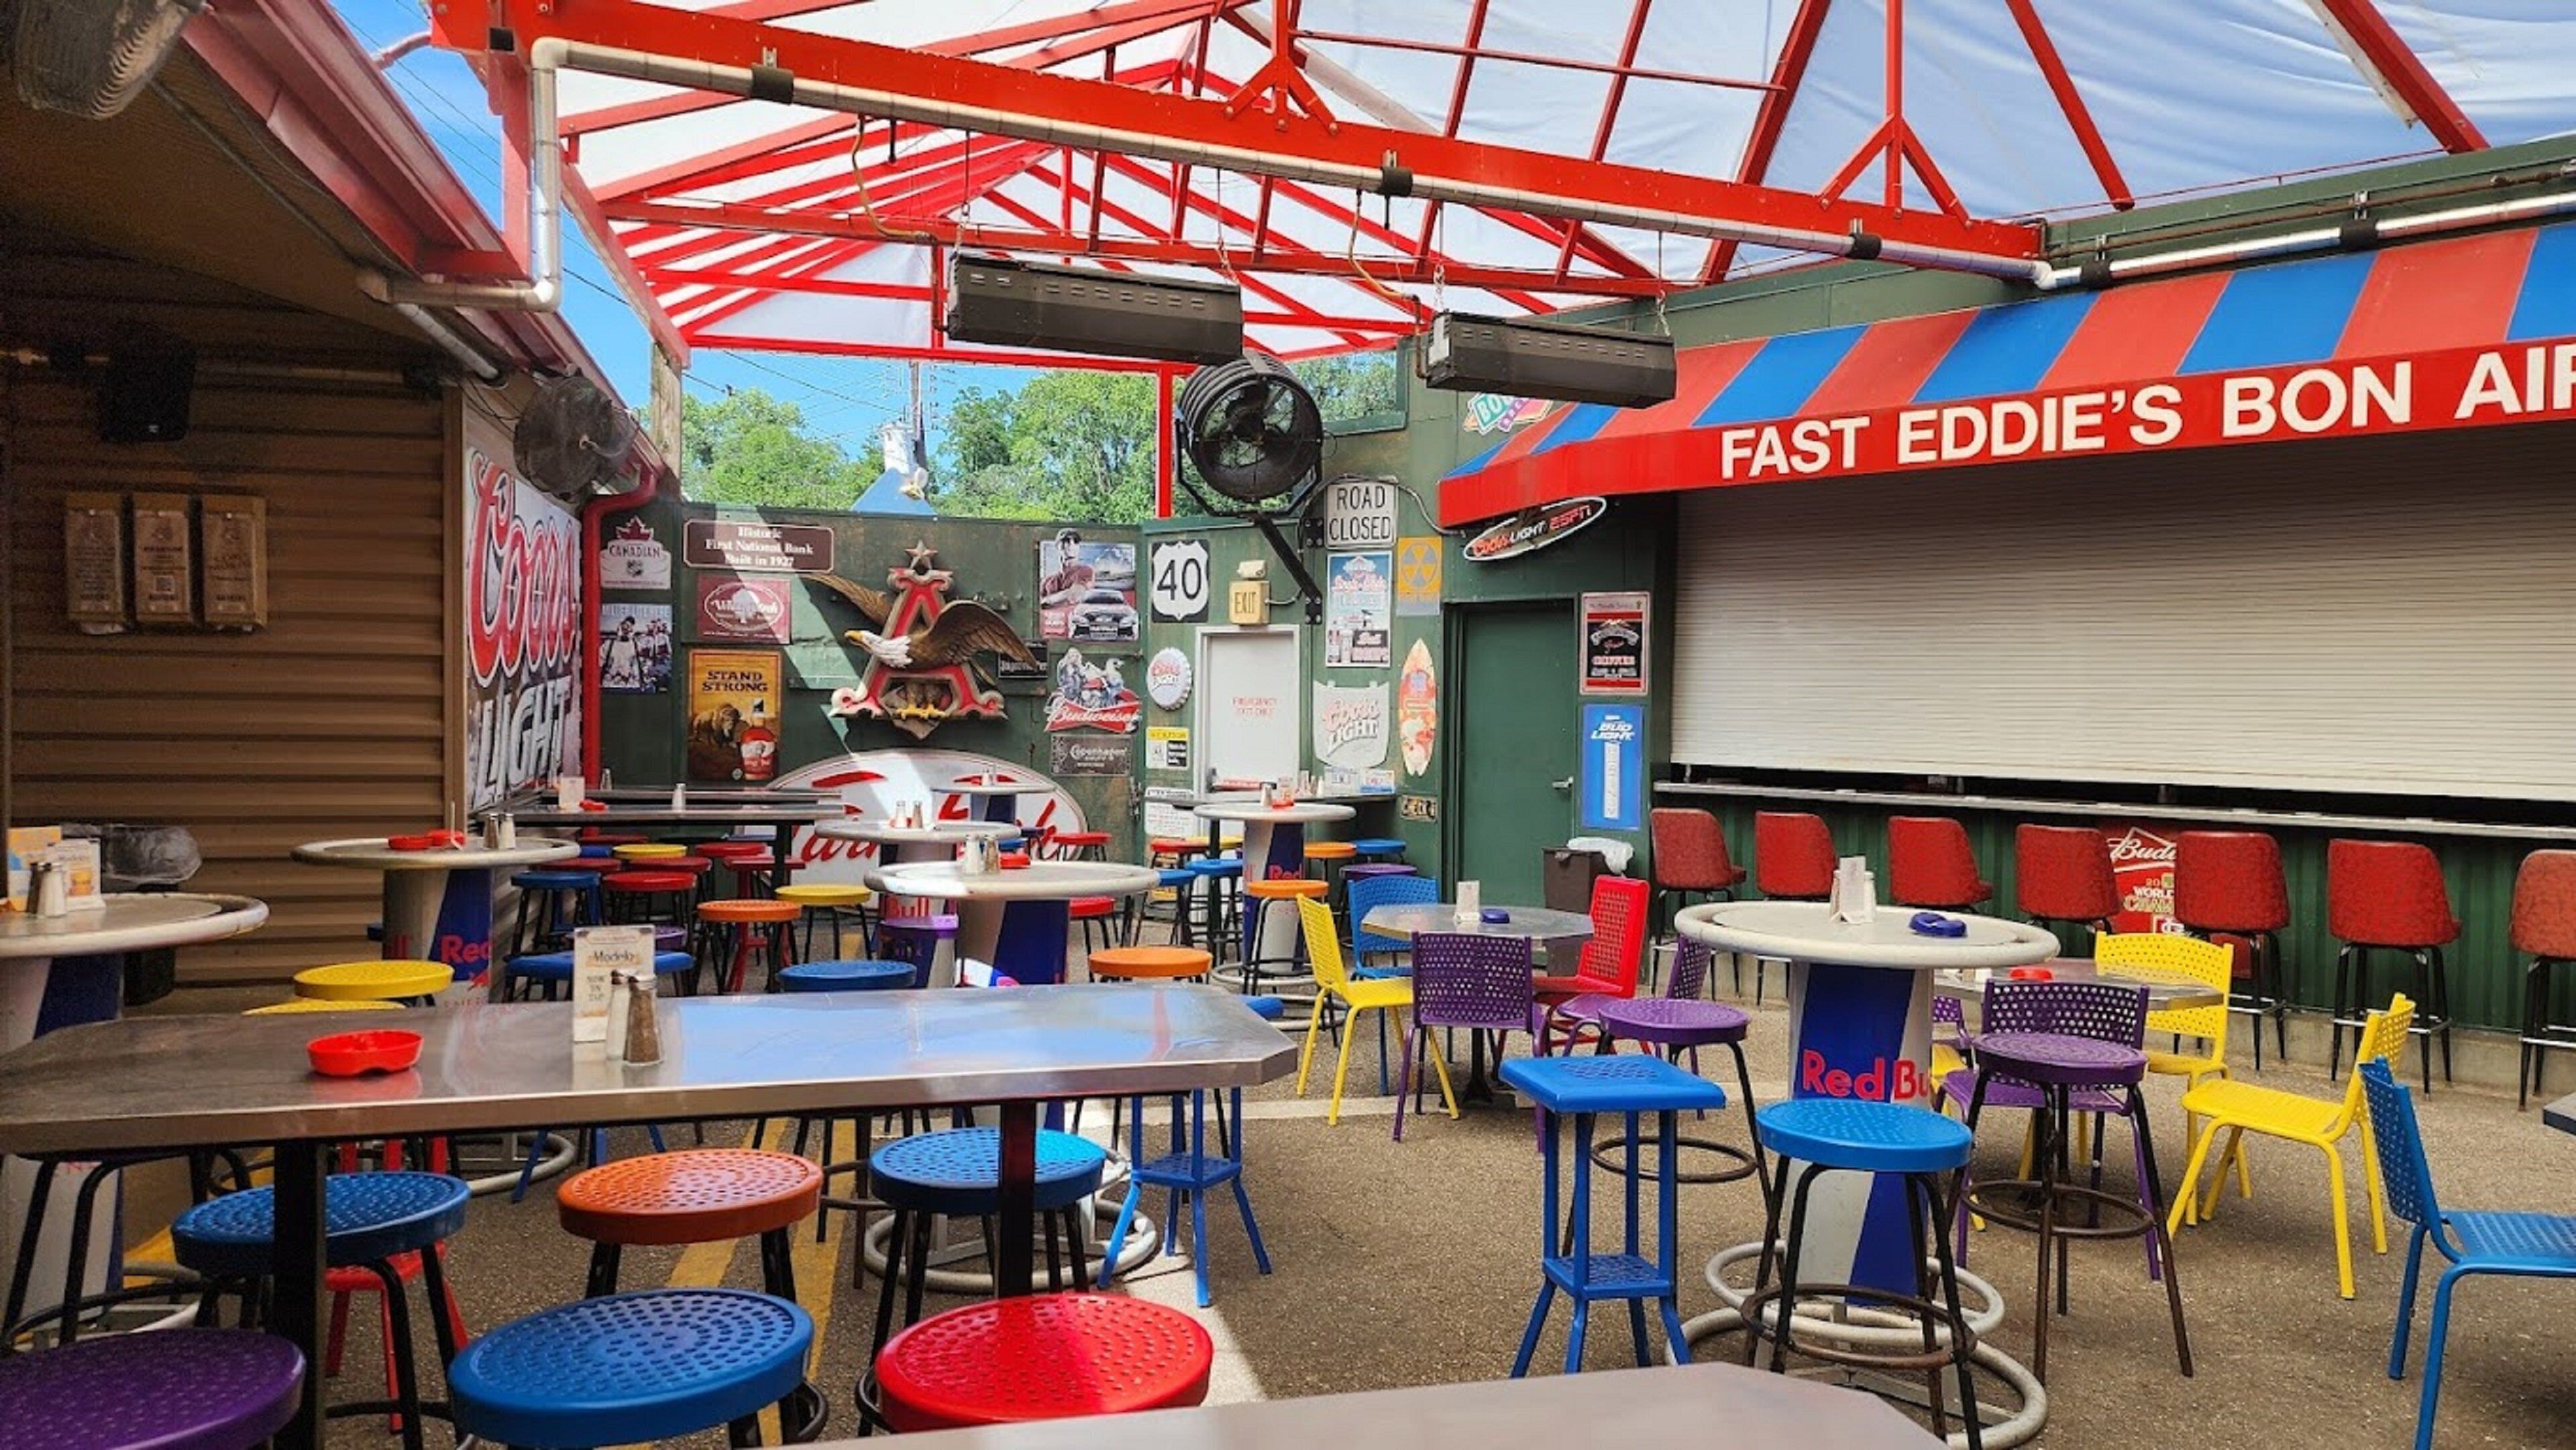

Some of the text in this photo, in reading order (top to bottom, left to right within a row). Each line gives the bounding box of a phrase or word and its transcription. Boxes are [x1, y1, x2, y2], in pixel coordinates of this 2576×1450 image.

[1721, 414, 1871, 480] FAST
[1897, 384, 2184, 465] EDDIE'S
[2222, 359, 2412, 438] BON
[1336, 484, 1386, 511] ROAD
[738, 526, 782, 539] Historic
[1328, 514, 1391, 541] CLOSED
[1472, 504, 1592, 558] Coors LIGHT ESPN
[609, 544, 660, 558] CANADIAN
[706, 539, 814, 555] First National Bank
[725, 553, 751, 565] Built
[755, 554, 767, 565] in
[468, 450, 576, 689] Coors
[1157, 557, 1202, 602] 40
[1234, 591, 1256, 614] EXIT
[702, 681, 768, 692] STRONG
[707, 671, 763, 681] STAND
[1046, 706, 1139, 722] Budweiser
[1322, 697, 1381, 732] Coors
[472, 675, 573, 812] LIGHT
[1327, 720, 1379, 755] LIGHT
[1591, 730, 1635, 741] LIGHT
[592, 948, 635, 963] Modelo
[1802, 1048, 1886, 1101] Red
